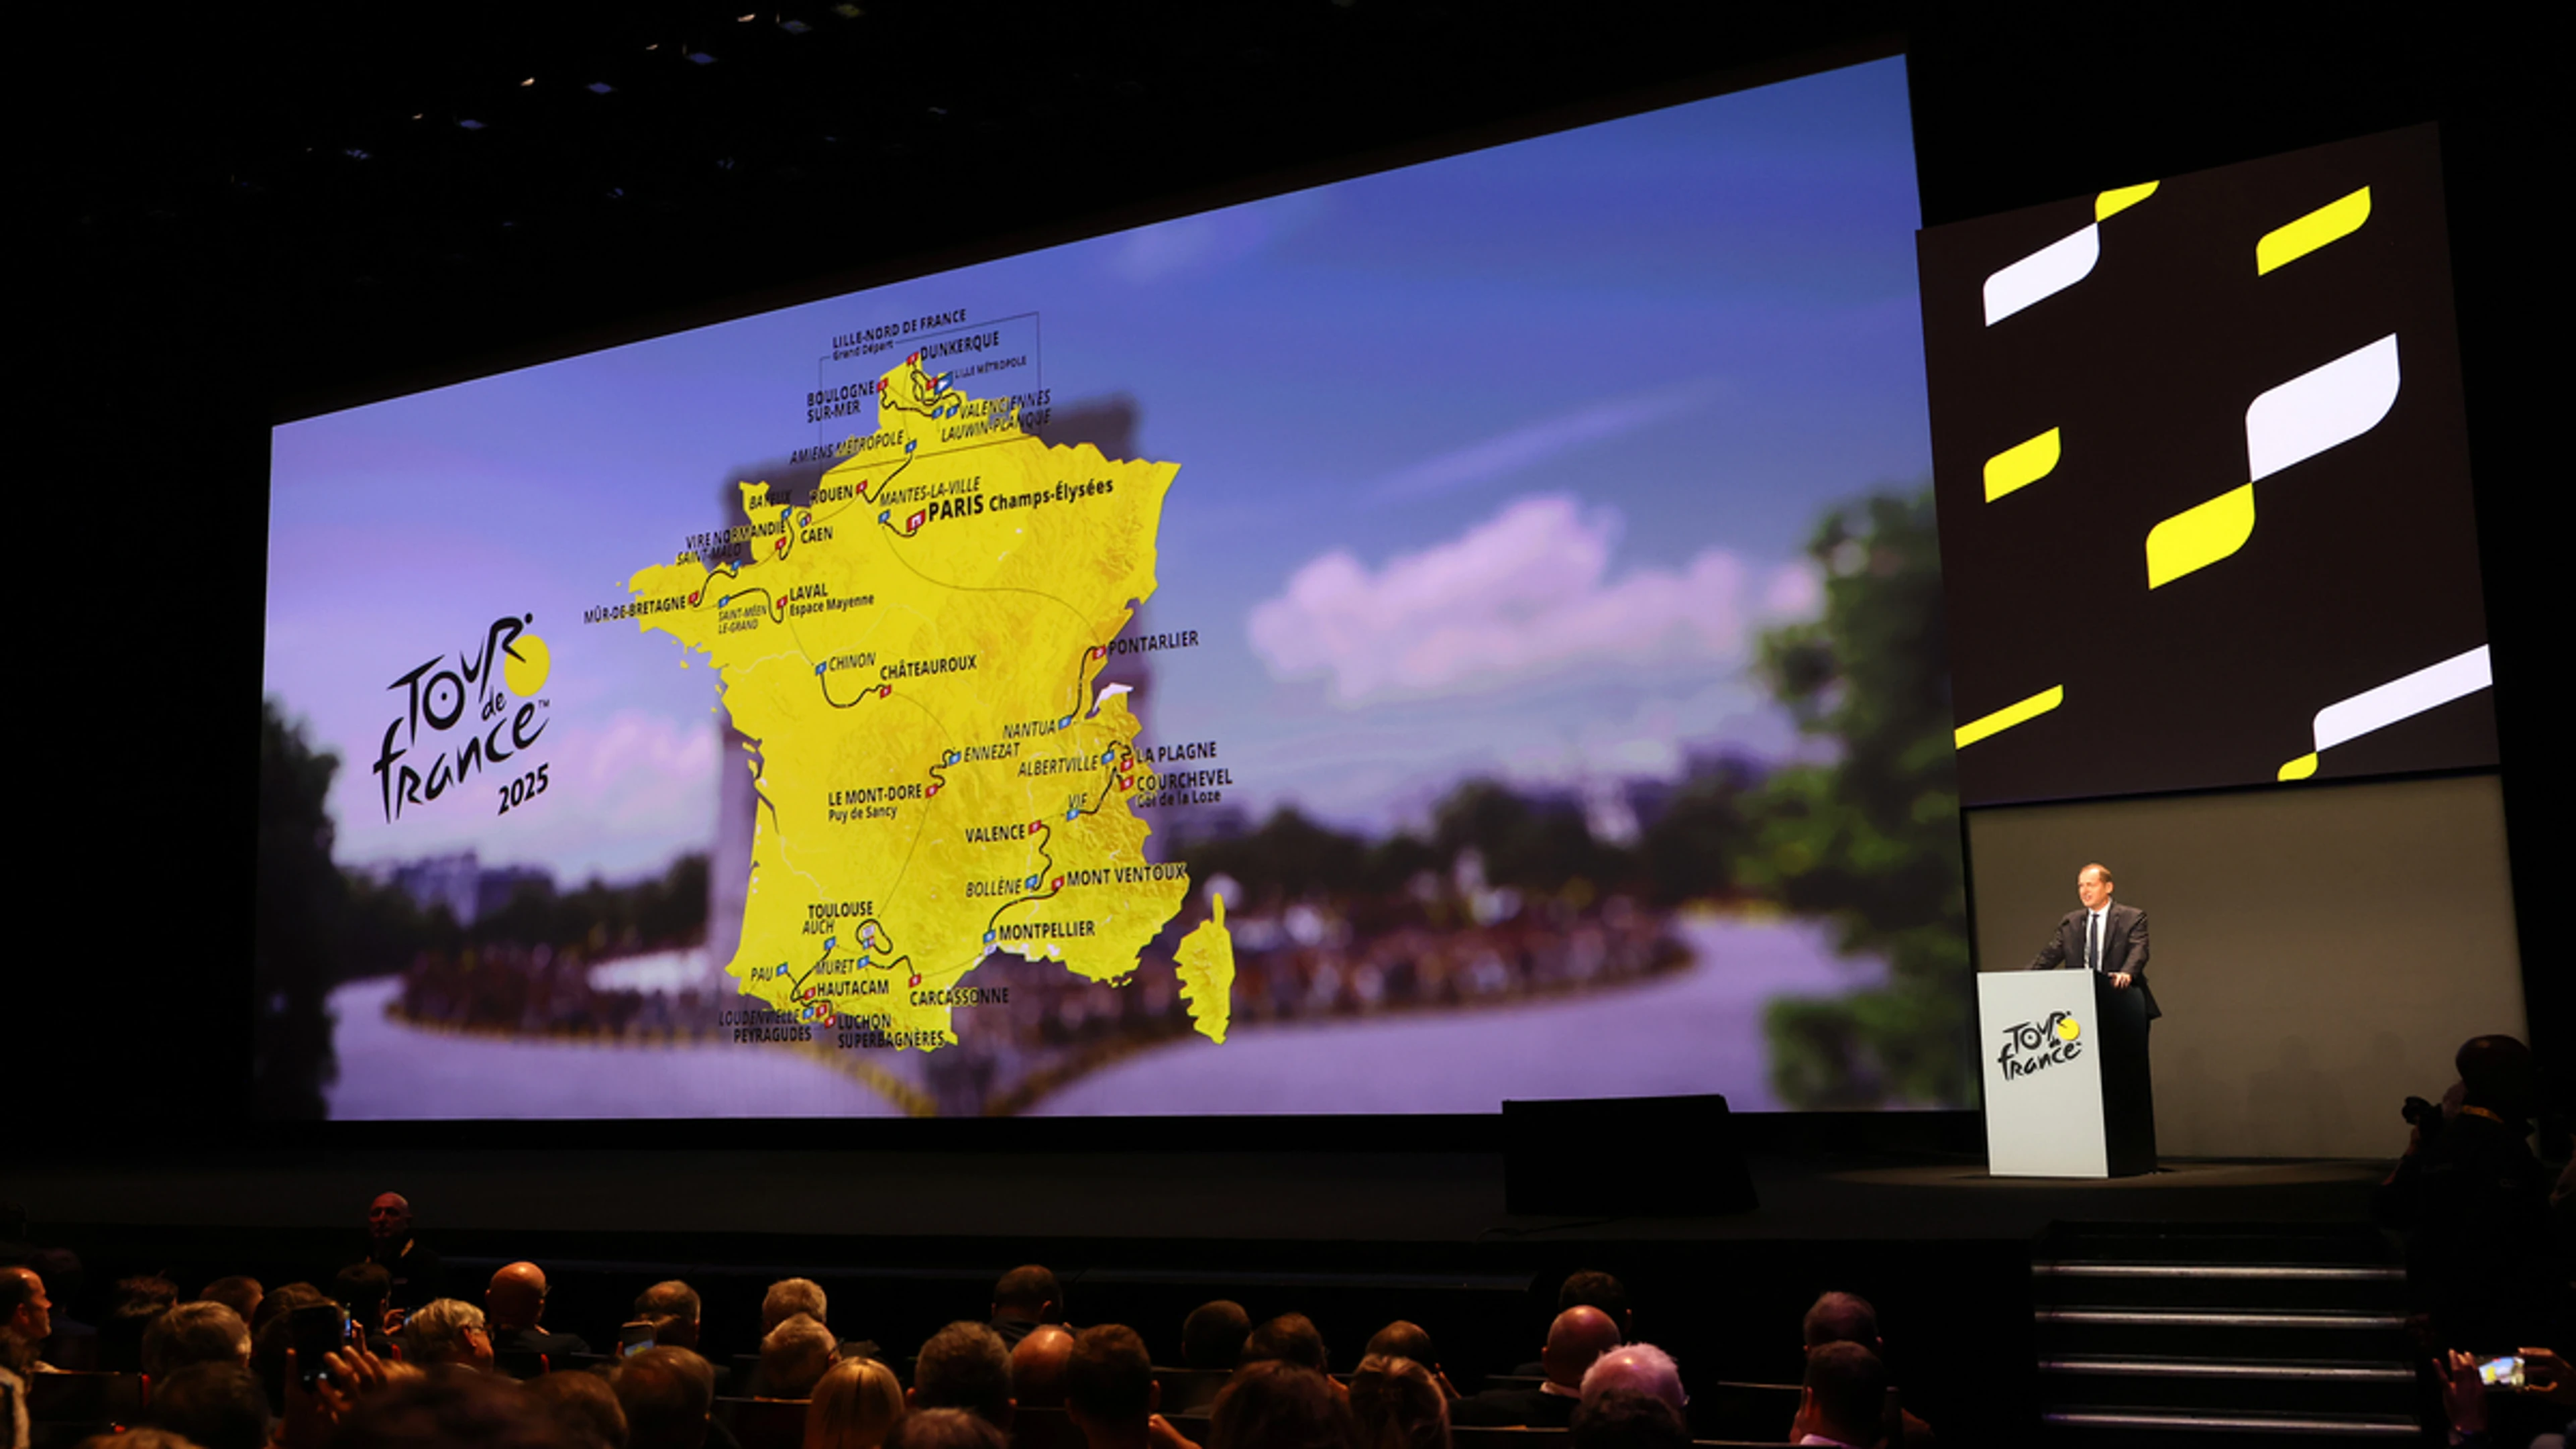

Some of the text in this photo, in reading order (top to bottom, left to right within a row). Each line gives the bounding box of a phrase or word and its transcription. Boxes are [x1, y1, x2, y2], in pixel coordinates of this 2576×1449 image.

[833, 309, 966, 348] LILLE-NORD DE FRANCE
[833, 347, 859, 361] Grand
[920, 331, 999, 361] DUNKERQUE
[955, 365, 975, 379] LILLE
[807, 380, 874, 407] BOULOGNE
[961, 388, 1051, 419] VALENCIENNES
[807, 400, 861, 423] SUR-MER
[941, 409, 1051, 443] LAUWIN-PLANQUE
[790, 443, 833, 465] AMIENS
[810, 485, 853, 504] ROUEN
[880, 476, 980, 506] MANTES-LA-VILLE
[928, 478, 1114, 522] PARIS Champs-Élysées
[686, 521, 786, 549] VIRE NORMANDIE
[800, 527, 833, 543] CAEN
[677, 543, 741, 566] SAINT-MALO
[790, 584, 827, 601] LAVAL
[584, 595, 686, 624] MÛR-DE-BRETAGNE
[790, 595, 874, 617] Espace Mayenne
[718, 619, 759, 634] LE-GRAND
[1108, 631, 1199, 655] PONTARLIER
[829, 652, 876, 672] CHINON
[880, 655, 977, 681] CHÂTEAUROUX
[386, 616, 527, 747] TOUR
[481, 685, 506, 722] de
[1003, 720, 1055, 739] NANTUA
[964, 743, 1020, 763] ENNEZAT
[1136, 741, 1217, 763] LA PLAGNE
[1018, 755, 1098, 777] ALBERTVILLE
[498, 762, 549, 816] 2025
[1137, 769, 1233, 791] COURCHEVEL
[828, 784, 922, 806] LE MONT-DORE
[1069, 793, 1087, 808] VIF
[1138, 790, 1222, 808] Col de la Loze
[828, 806, 898, 824] Puy de Sancy
[965, 824, 1025, 843] VALENCE
[1067, 863, 1187, 886] MONT VENTOUX
[966, 878, 1022, 898] BOLLÈNE
[808, 901, 873, 919] TOULOUSE
[802, 919, 835, 934] AUCH
[1000, 920, 1095, 941] MONTPELLIER
[751, 967, 773, 981] PAU
[815, 959, 855, 975] MURET
[817, 980, 889, 997] HAUTACAM
[909, 987, 1008, 1007] CARCASSONNE
[718, 1008, 799, 1027] LOUDENVIELLE
[839, 1014, 891, 1030] LUCHON
[734, 1026, 812, 1043] PEYRAGUDES
[839, 1027, 945, 1049] SUPERBAGNÈRES
[2002, 1011, 2068, 1054] TOUR
